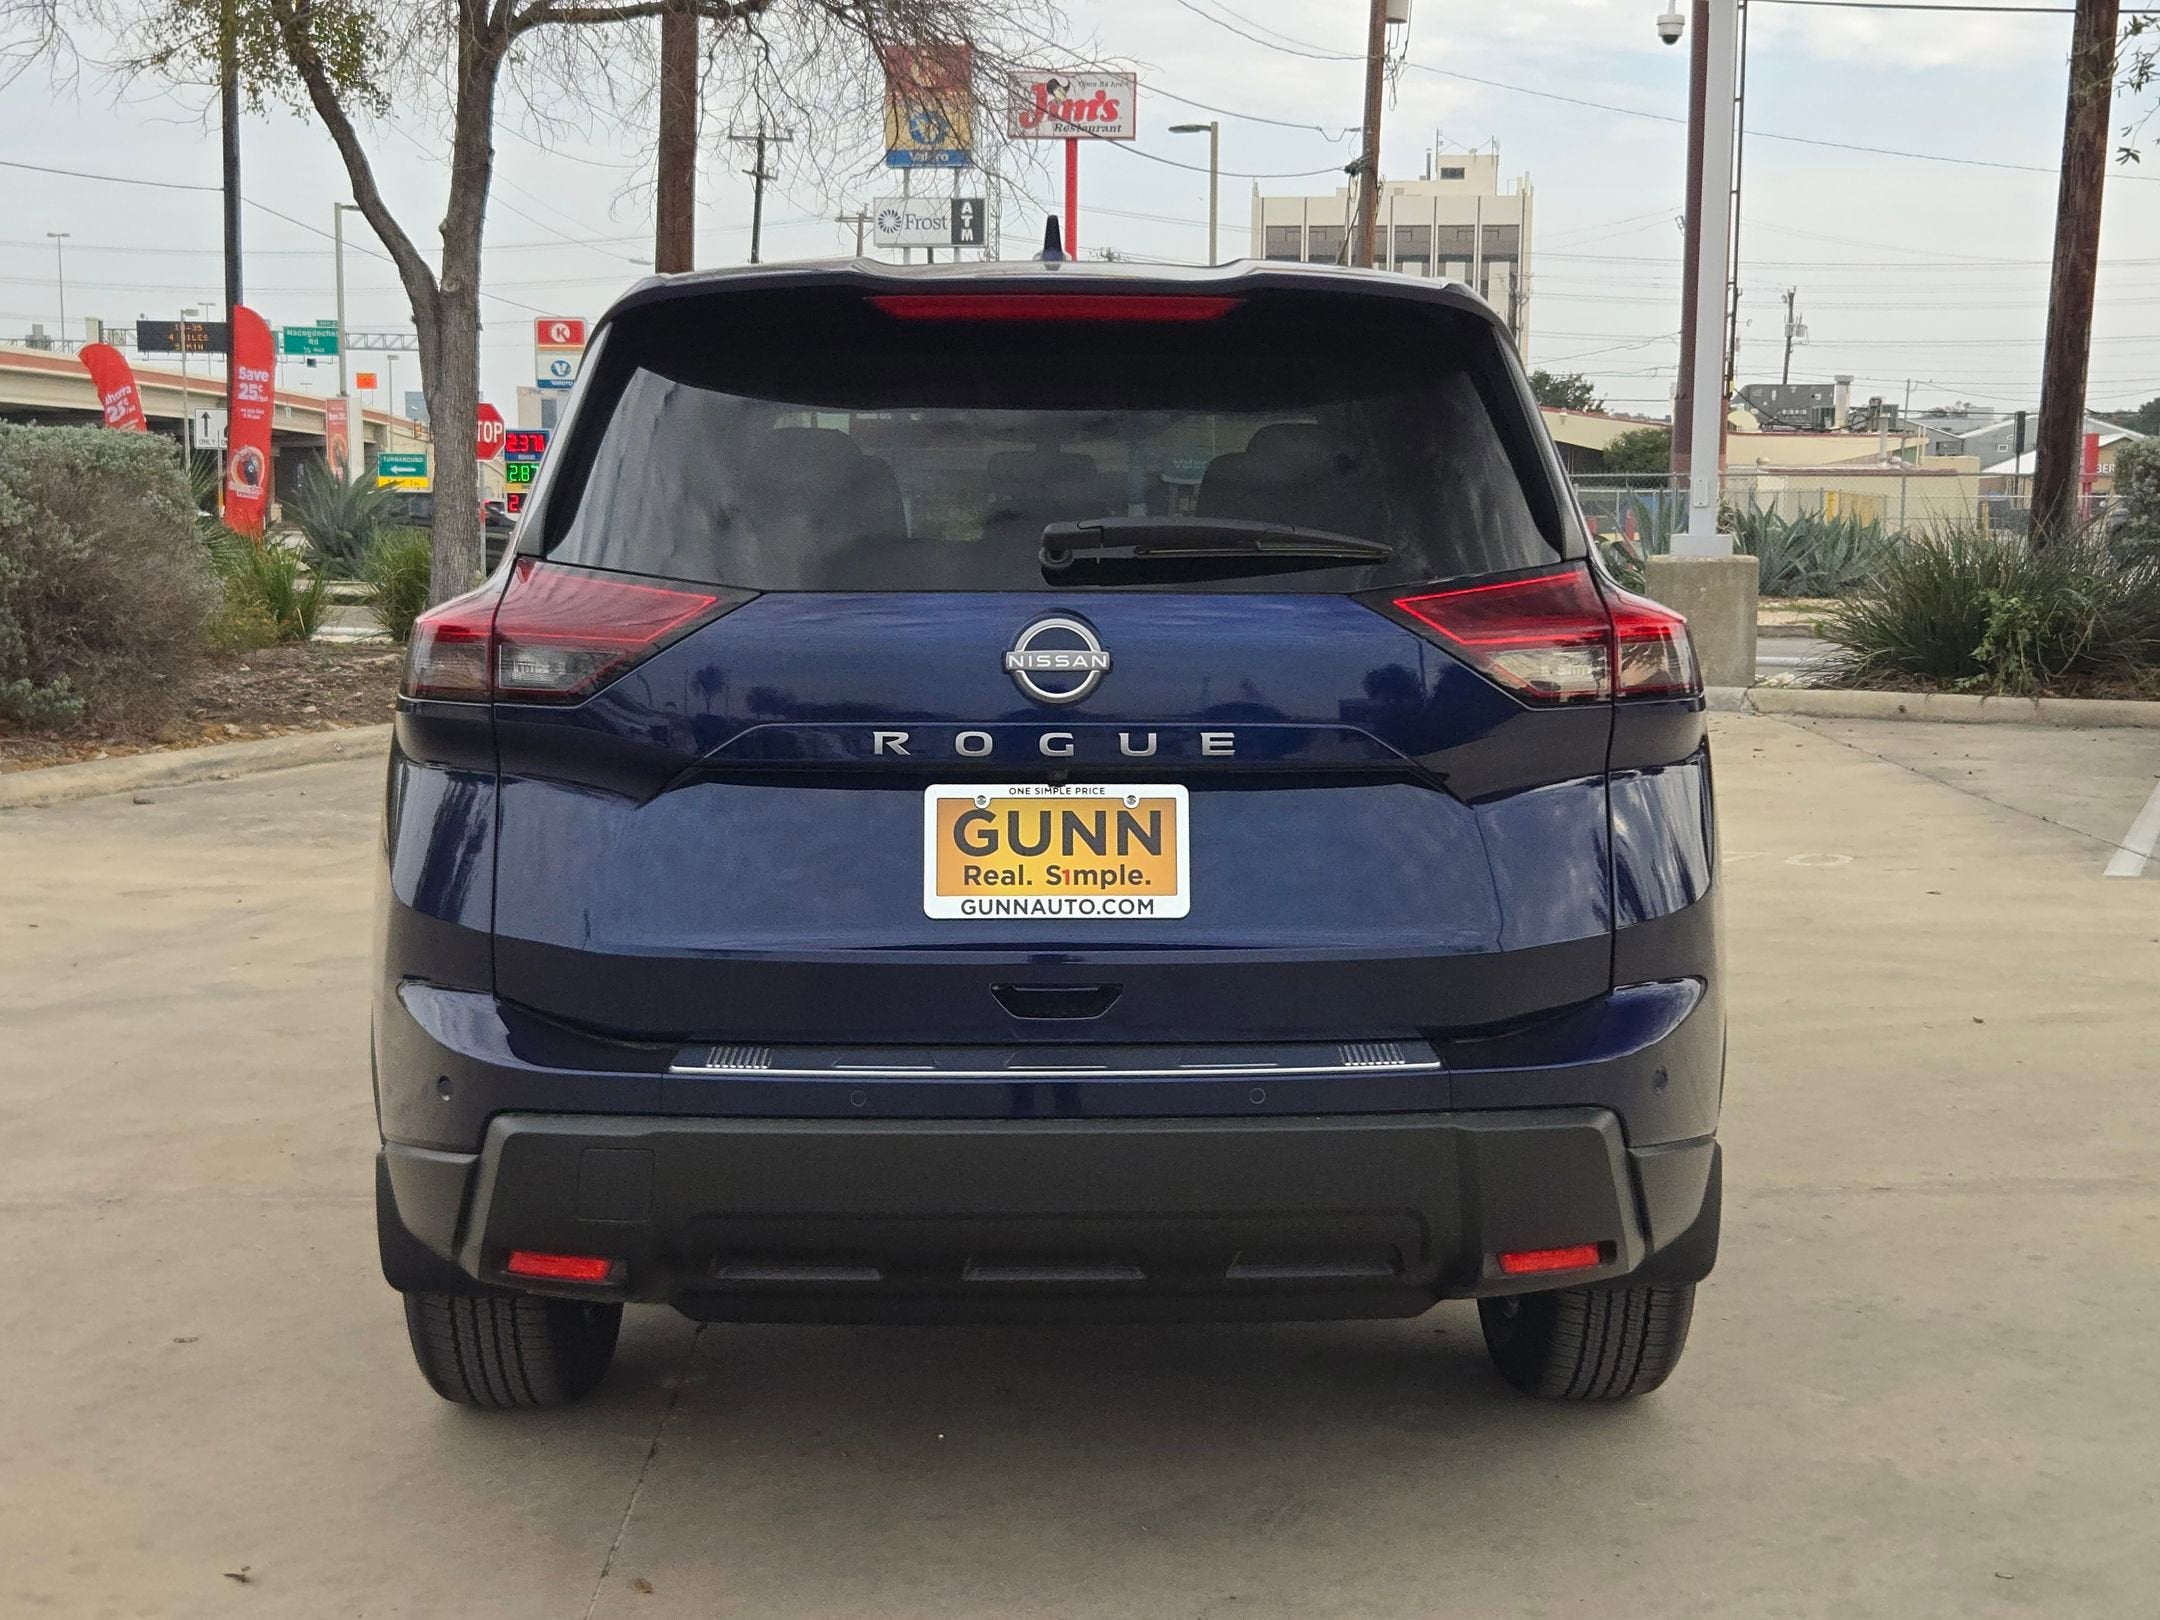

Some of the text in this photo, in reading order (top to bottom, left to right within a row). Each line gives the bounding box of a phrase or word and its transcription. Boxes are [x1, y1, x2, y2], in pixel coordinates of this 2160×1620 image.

[1019, 83, 1120, 128] Jim's
[1055, 123, 1122, 132] Restaurant
[911, 152, 949, 161] Valro
[905, 214, 948, 230] Frost
[961, 202, 973, 241] ATM
[182, 334, 208, 342] ILES
[286, 328, 338, 337] Nacogdoche
[239, 366, 269, 382] Save
[477, 421, 503, 443] TOP
[1008, 655, 1107, 668] NISSAN
[873, 731, 1236, 757] ROGUE
[1009, 786, 1106, 795] ONE SIMPLE PRICE
[953, 808, 1162, 857] GUNN
[964, 864, 1151, 889] Real. S1mple.
[961, 898, 1154, 915] GUNNAUTO.COM
